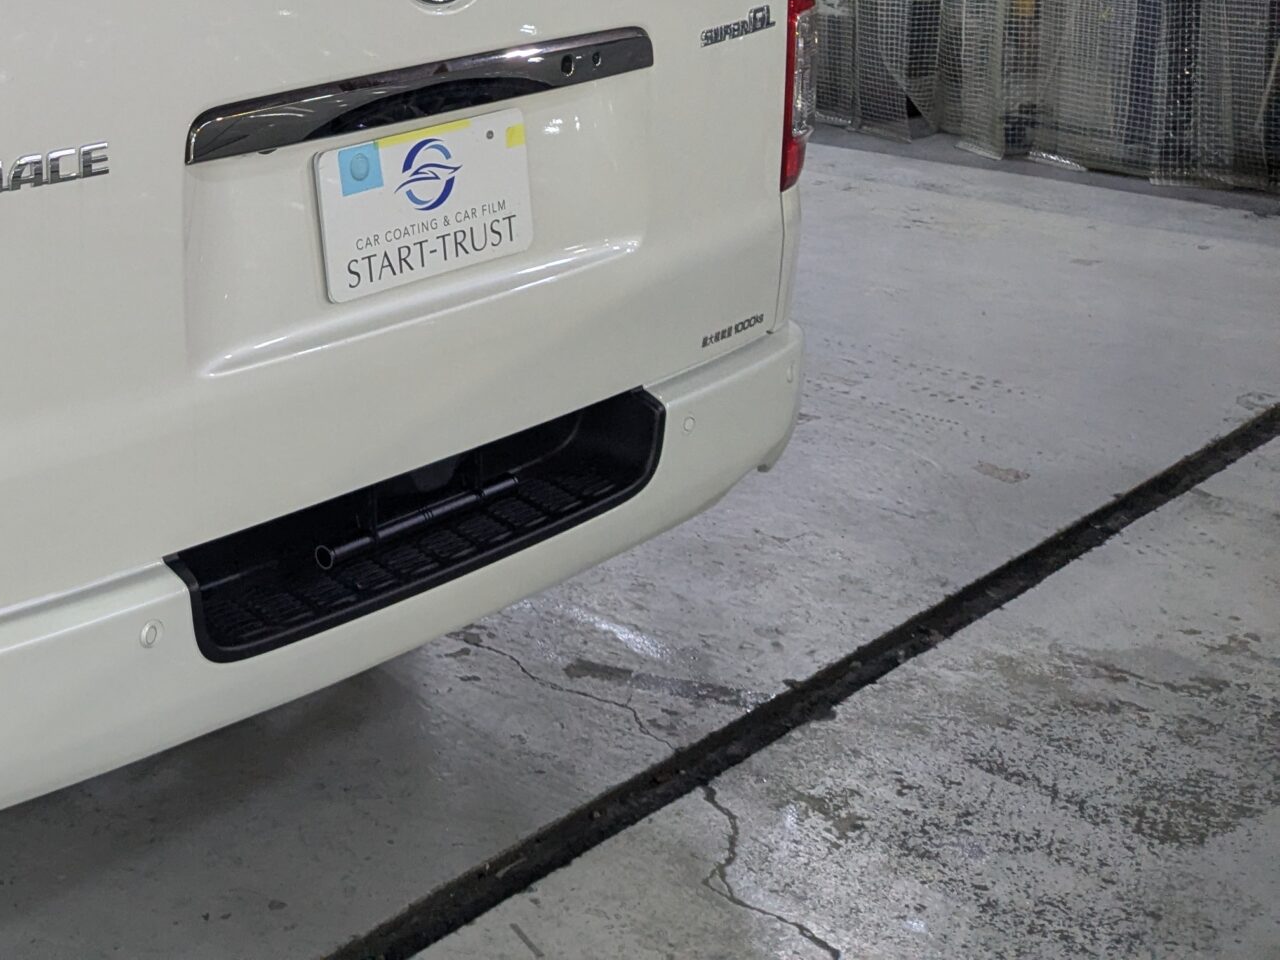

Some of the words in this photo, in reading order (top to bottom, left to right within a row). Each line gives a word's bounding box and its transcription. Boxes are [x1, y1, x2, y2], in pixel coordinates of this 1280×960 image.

[346, 214, 517, 289] START-TRUST
[355, 234, 380, 251] CAR
[384, 218, 439, 243] COATING
[443, 215, 451, 227] &
[455, 207, 478, 224] CAR
[481, 199, 507, 217] FILM
